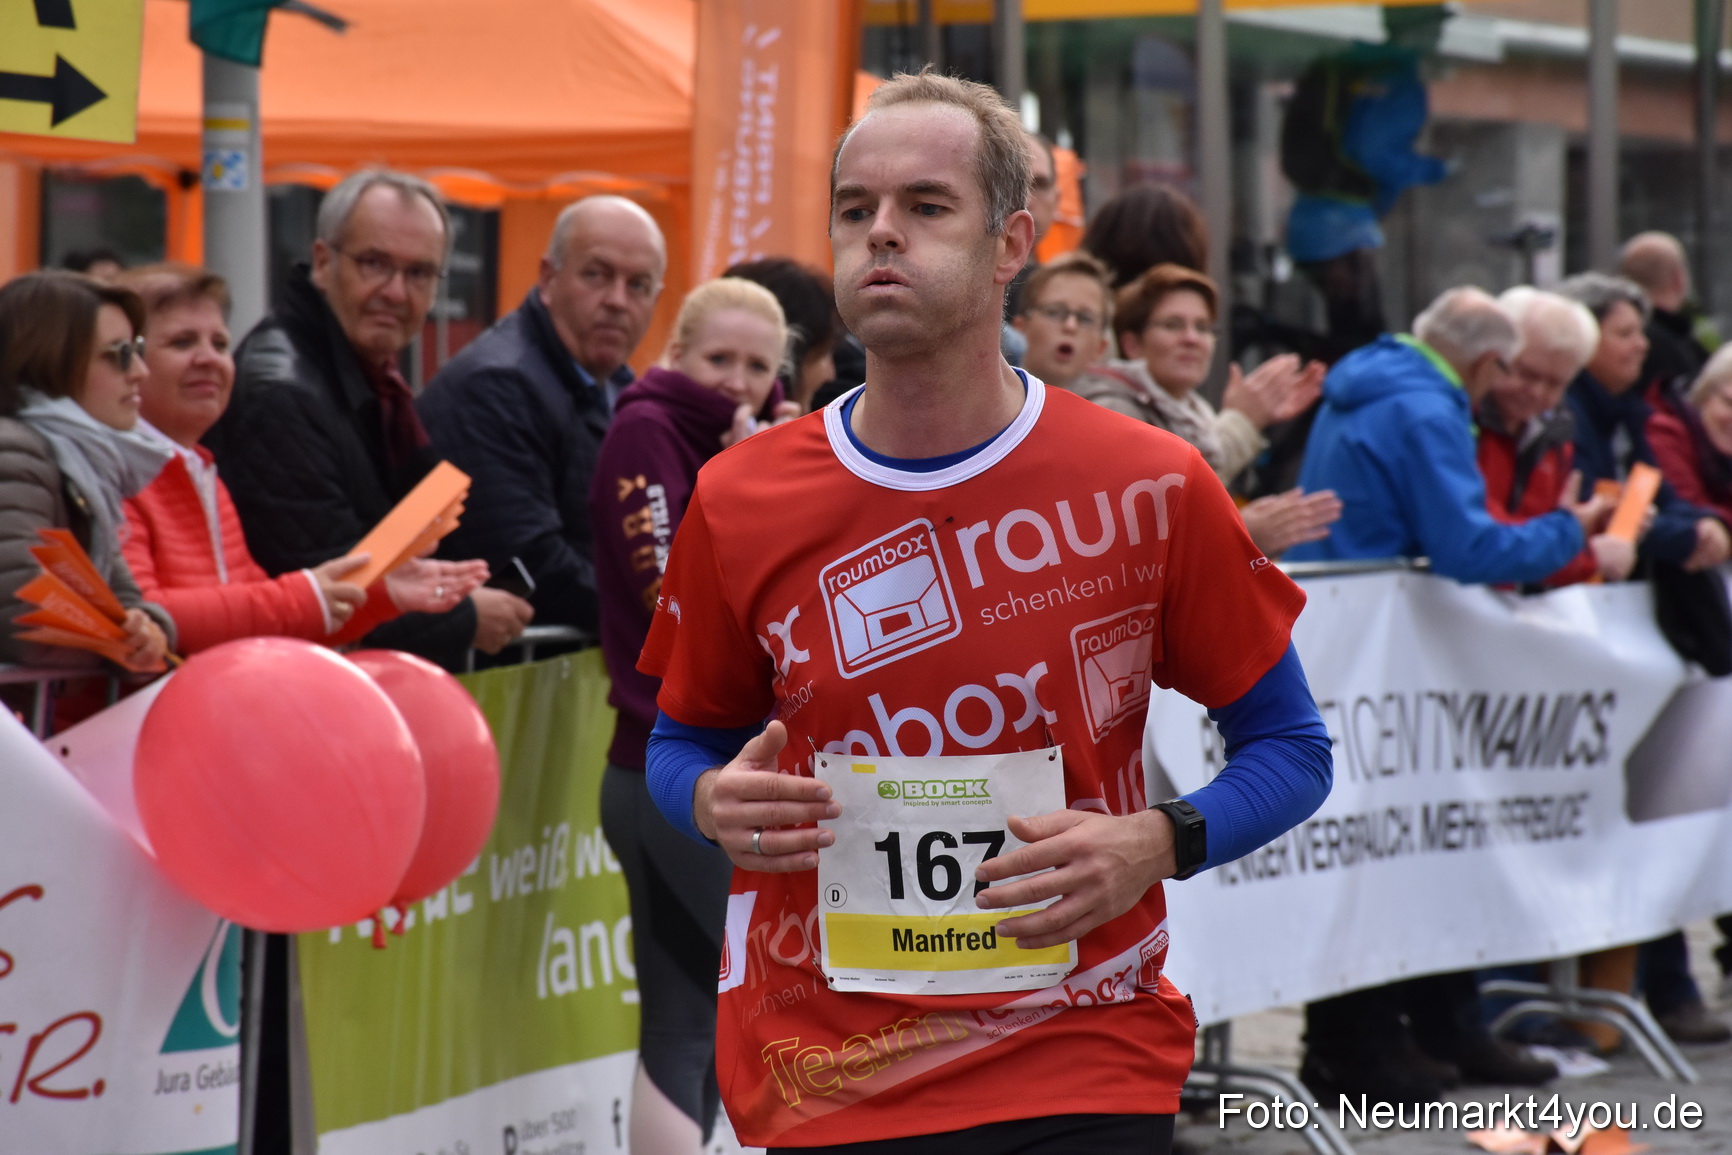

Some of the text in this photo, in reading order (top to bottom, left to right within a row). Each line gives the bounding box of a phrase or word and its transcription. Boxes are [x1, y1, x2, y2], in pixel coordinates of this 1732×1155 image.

[828, 533, 928, 594] raumbox
[980, 573, 1114, 626] schenken
[902, 779, 992, 800] BOCK
[903, 799, 930, 807] inspired
[931, 799, 940, 807] by
[962, 798, 992, 807] concepts
[875, 830, 1006, 901] 167
[892, 926, 998, 952] Manfred
[1142, 934, 1169, 960] raumbox
[761, 1011, 969, 1109] Team
[154, 1067, 191, 1096] Jura
